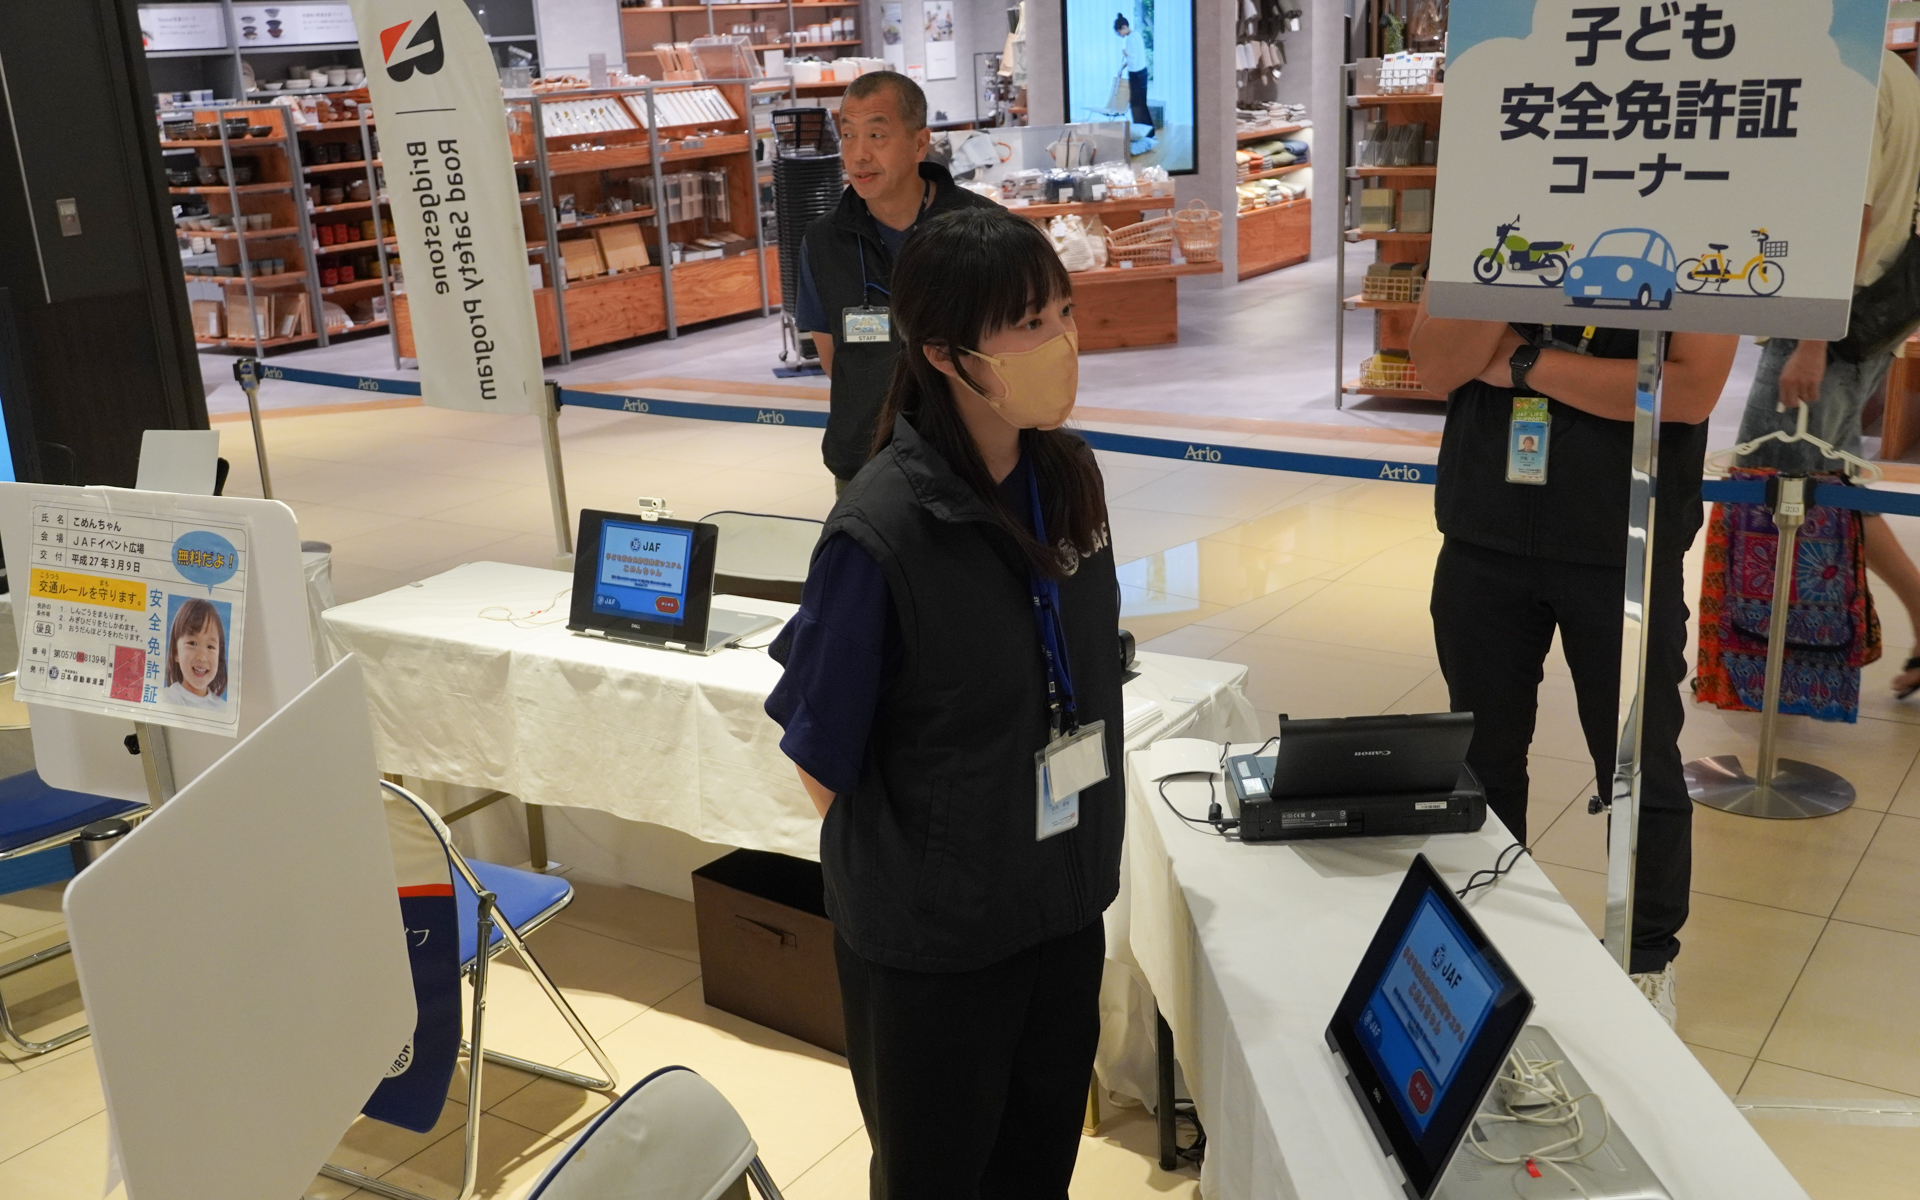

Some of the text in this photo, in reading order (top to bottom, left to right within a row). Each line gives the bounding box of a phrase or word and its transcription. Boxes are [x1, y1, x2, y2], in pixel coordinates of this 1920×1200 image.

[1565, 1, 1736, 67] 子ども
[1500, 78, 1802, 141] 安全免許証
[1549, 153, 1729, 197] コーナー
[263, 366, 283, 379] Ario
[358, 378, 379, 391] Ario
[622, 398, 649, 413] Ario
[756, 409, 785, 424] Ario
[1183, 444, 1222, 462] Ario
[1378, 463, 1421, 481] Ario
[1785, 505, 1800, 513] 233
[41, 513, 122, 532] 氏名 こめんちゃん
[40, 531, 64, 543] 会場
[642, 541, 661, 552] JAF
[40, 549, 63, 562] 交付
[40, 571, 60, 580] こうつう
[38, 580, 141, 606] 交通ルールを守ります。
[70, 606, 128, 622] しんごうをまもります。
[36, 622, 52, 635] 優良
[68, 616, 138, 633] みぎひだりをたしかめます。
[68, 626, 143, 642] おうだんほどうをわたります。
[32, 647, 47, 657] 番号
[142, 588, 163, 704] 安全免許証
[1441, 962, 1463, 989] JAF
[1369, 1020, 1382, 1037] JAF
